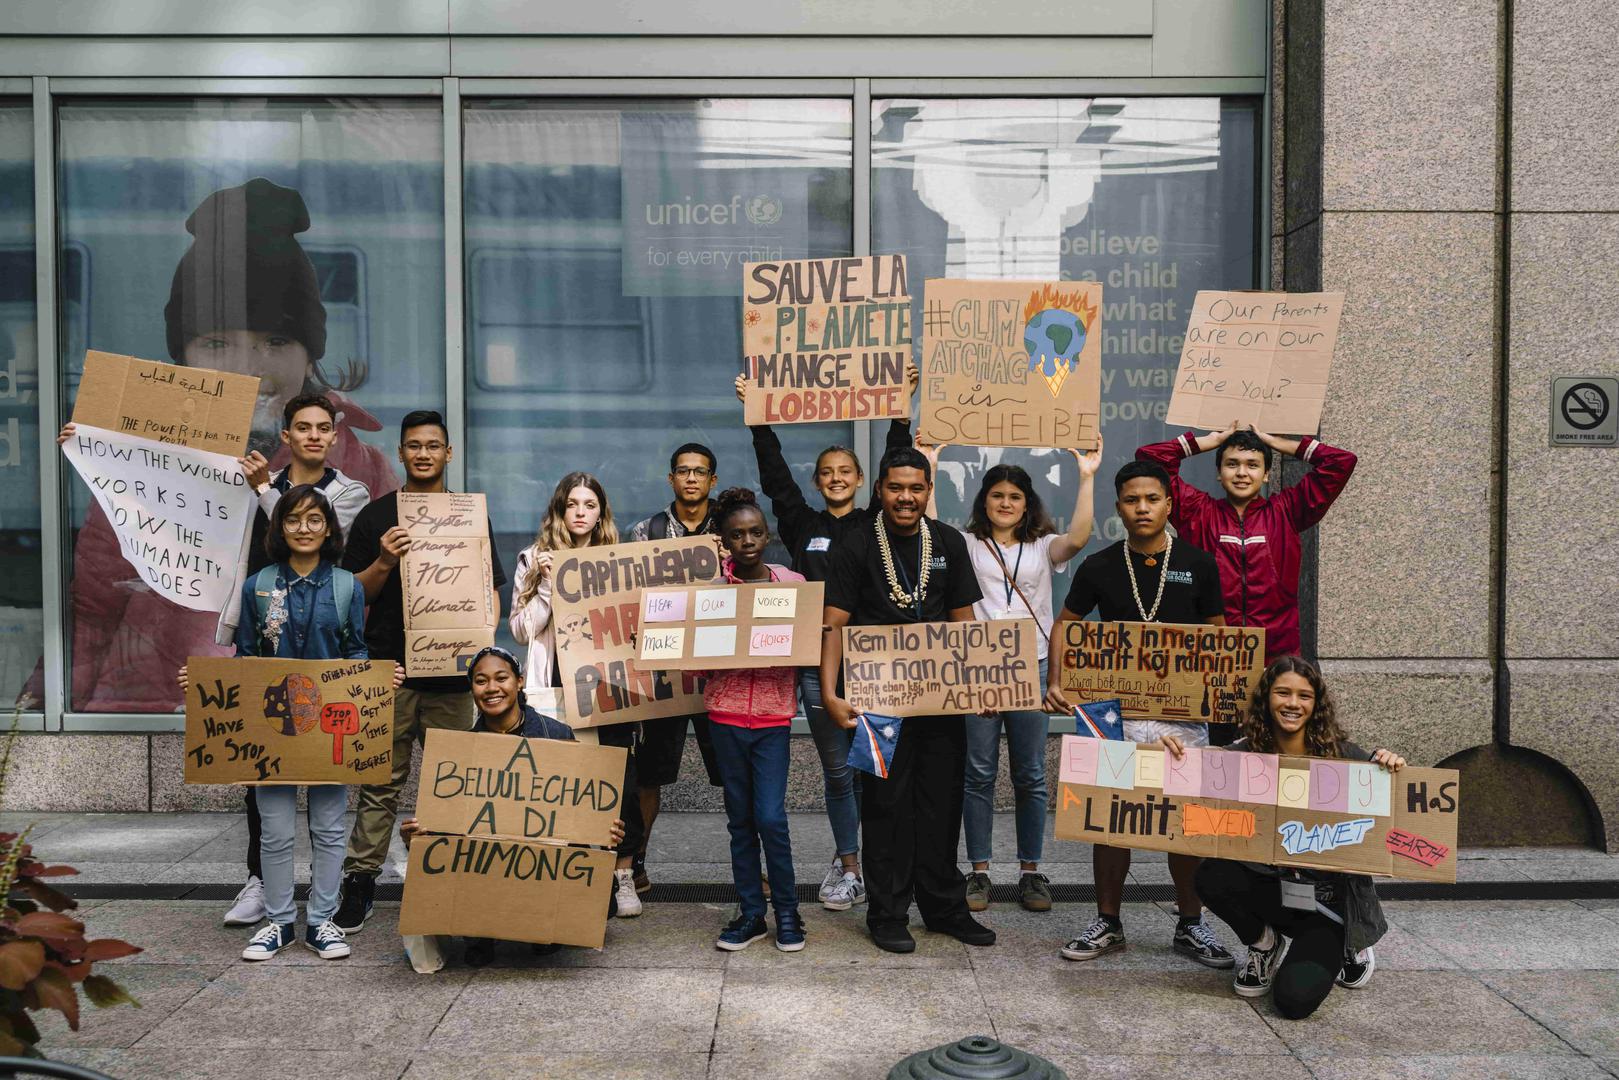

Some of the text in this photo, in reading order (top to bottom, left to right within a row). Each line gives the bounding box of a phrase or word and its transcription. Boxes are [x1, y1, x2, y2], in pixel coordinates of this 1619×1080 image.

[646, 195, 741, 225] unicef
[647, 246, 783, 270] for every child
[748, 255, 908, 305] SAUVE LA
[1107, 262, 1177, 288] child
[1102, 295, 1177, 321] what
[1208, 299, 1329, 322] Our Parents
[1102, 328, 1184, 354] hildre
[1189, 327, 1227, 345] are
[1238, 331, 1269, 346] on
[757, 351, 904, 389] MANGE UN
[1184, 350, 1223, 369] Side
[957, 384, 1027, 407] is
[1181, 372, 1292, 401] Are You?
[1101, 400, 1168, 427] pove
[121, 416, 241, 443] THE POWER IS FOR THE
[158, 435, 188, 446] YOUTH
[78, 435, 245, 487] HOW THE WORLD
[204, 500, 229, 520] IS
[174, 522, 204, 548] THE
[148, 566, 203, 597] DOES
[411, 595, 477, 617] Climate
[648, 597, 789, 613] HEAR OUR VOICES
[411, 635, 477, 658] Change
[752, 633, 790, 649] CHOICES
[847, 628, 887, 653] Kem
[892, 626, 920, 651] ilo
[1066, 622, 1133, 650] Oktak
[1140, 624, 1158, 649] in
[320, 660, 373, 683] OTHERWISE
[196, 679, 240, 711] WE
[347, 684, 389, 701] WE WILL
[942, 682, 1035, 710] Action!!!
[1156, 695, 1191, 708] #RMI
[325, 707, 351, 718] STOP
[360, 697, 393, 718] GET NOT
[203, 716, 245, 738] HAVE
[361, 722, 389, 739] TIME
[225, 738, 265, 761] STOP
[354, 750, 391, 772] REGRET
[504, 737, 538, 775] A
[255, 755, 281, 781] IT
[467, 800, 556, 838] A DI
[1063, 784, 1082, 811] A
[1183, 803, 1254, 838] EVEN
[1281, 819, 1374, 854] PLANET
[1386, 831, 1449, 861] EARTH
[422, 837, 595, 887] CHIMONG
